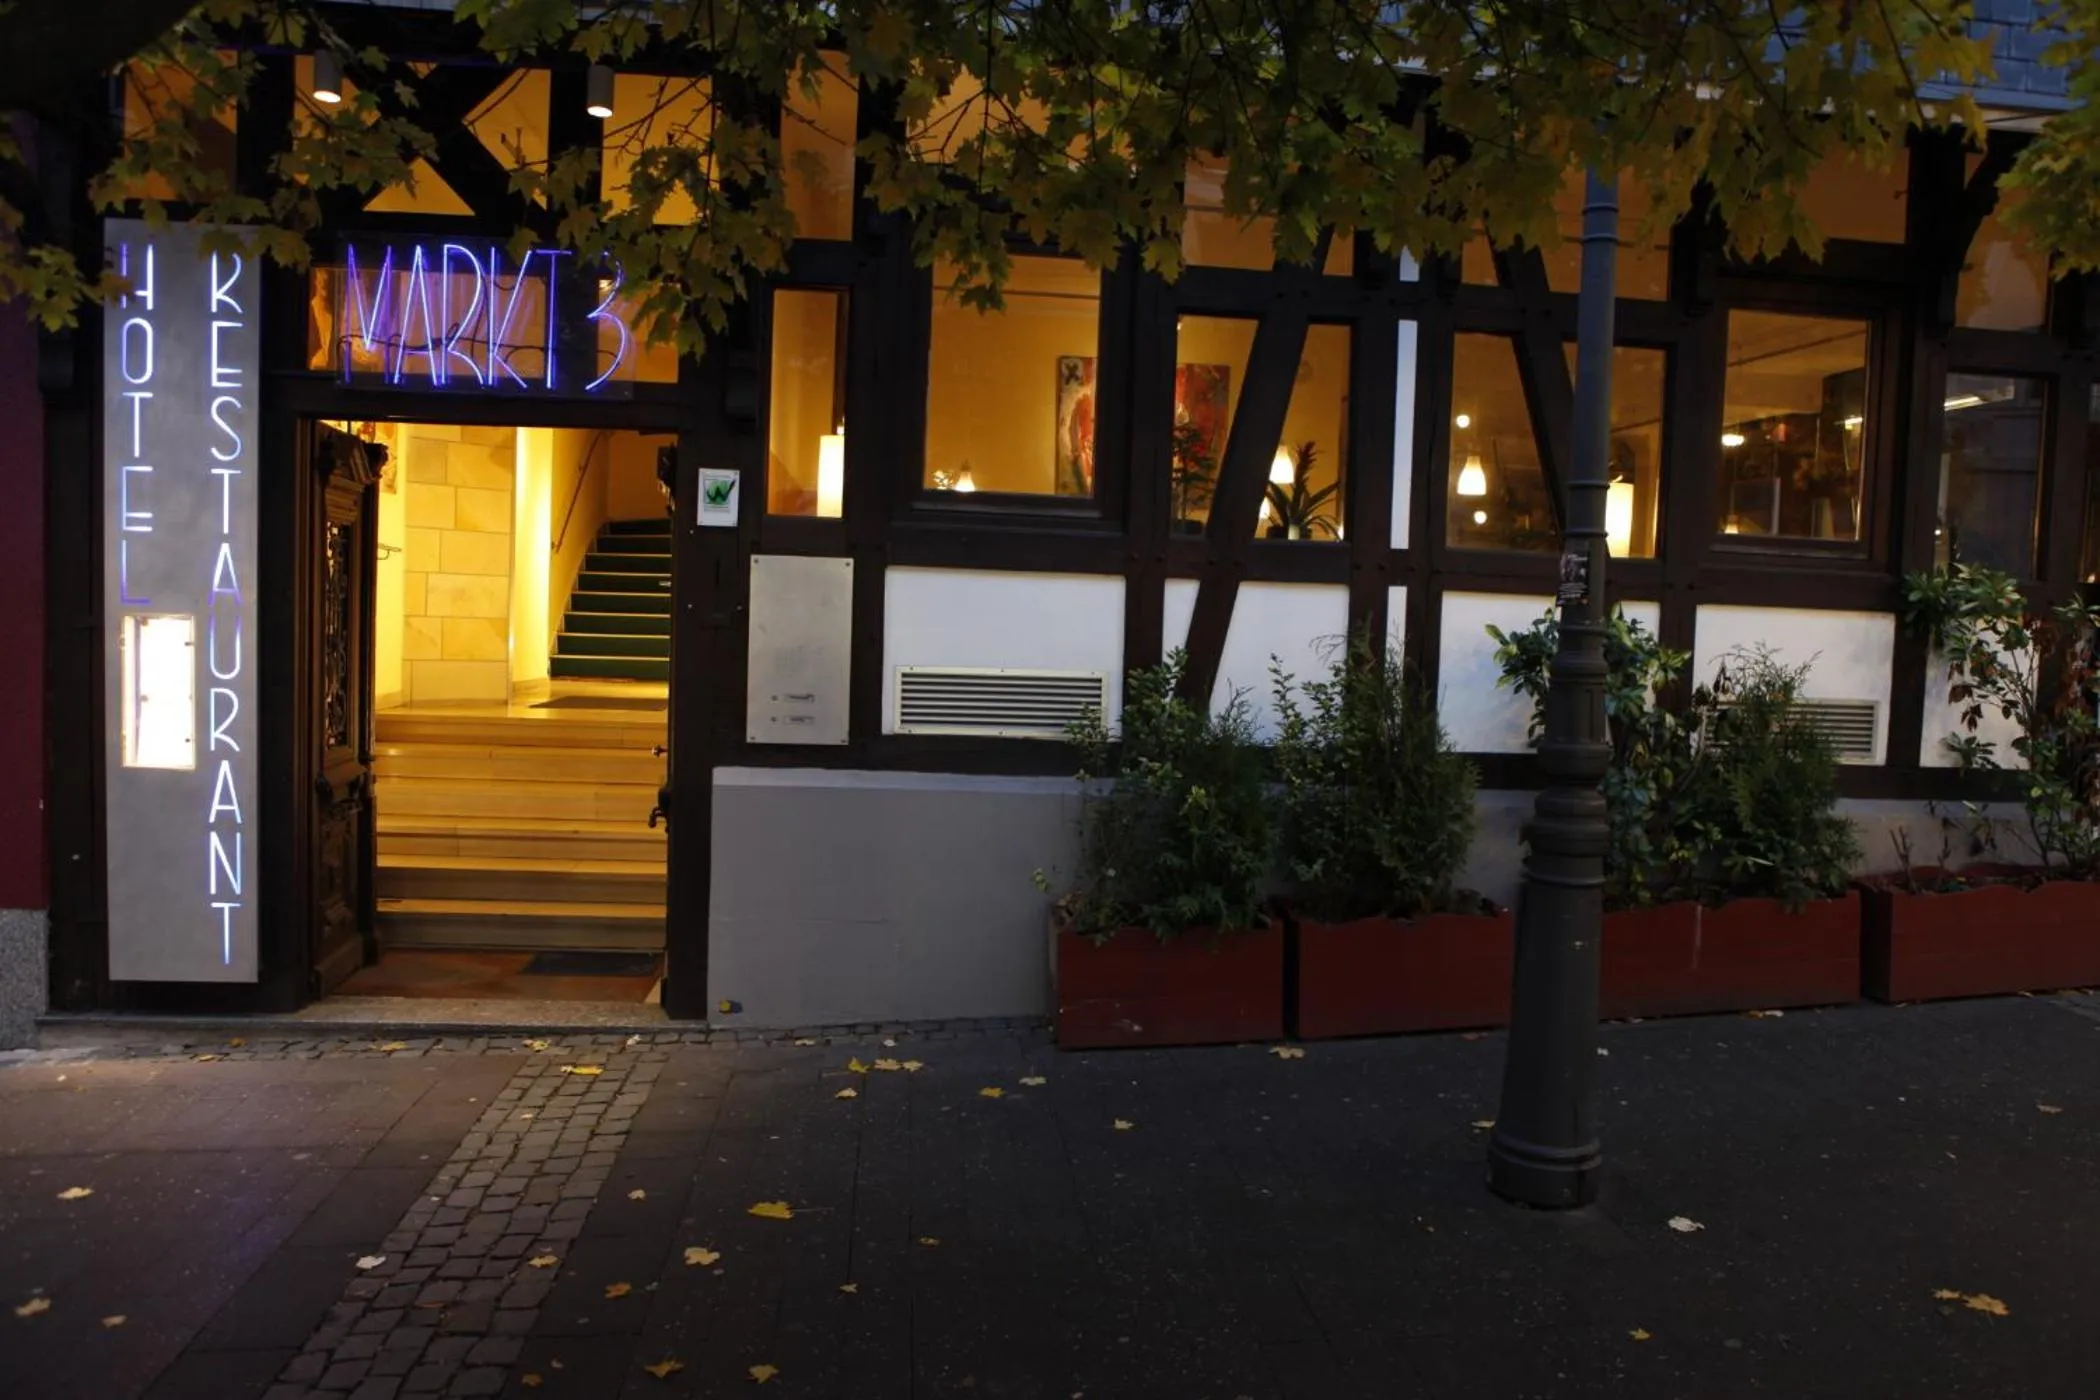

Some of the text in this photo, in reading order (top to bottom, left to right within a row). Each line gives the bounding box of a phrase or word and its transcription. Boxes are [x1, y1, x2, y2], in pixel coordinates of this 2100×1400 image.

[120, 243, 154, 605] HOTEL
[344, 243, 627, 392] MARKT 3
[208, 251, 244, 965] RESTAURANT
